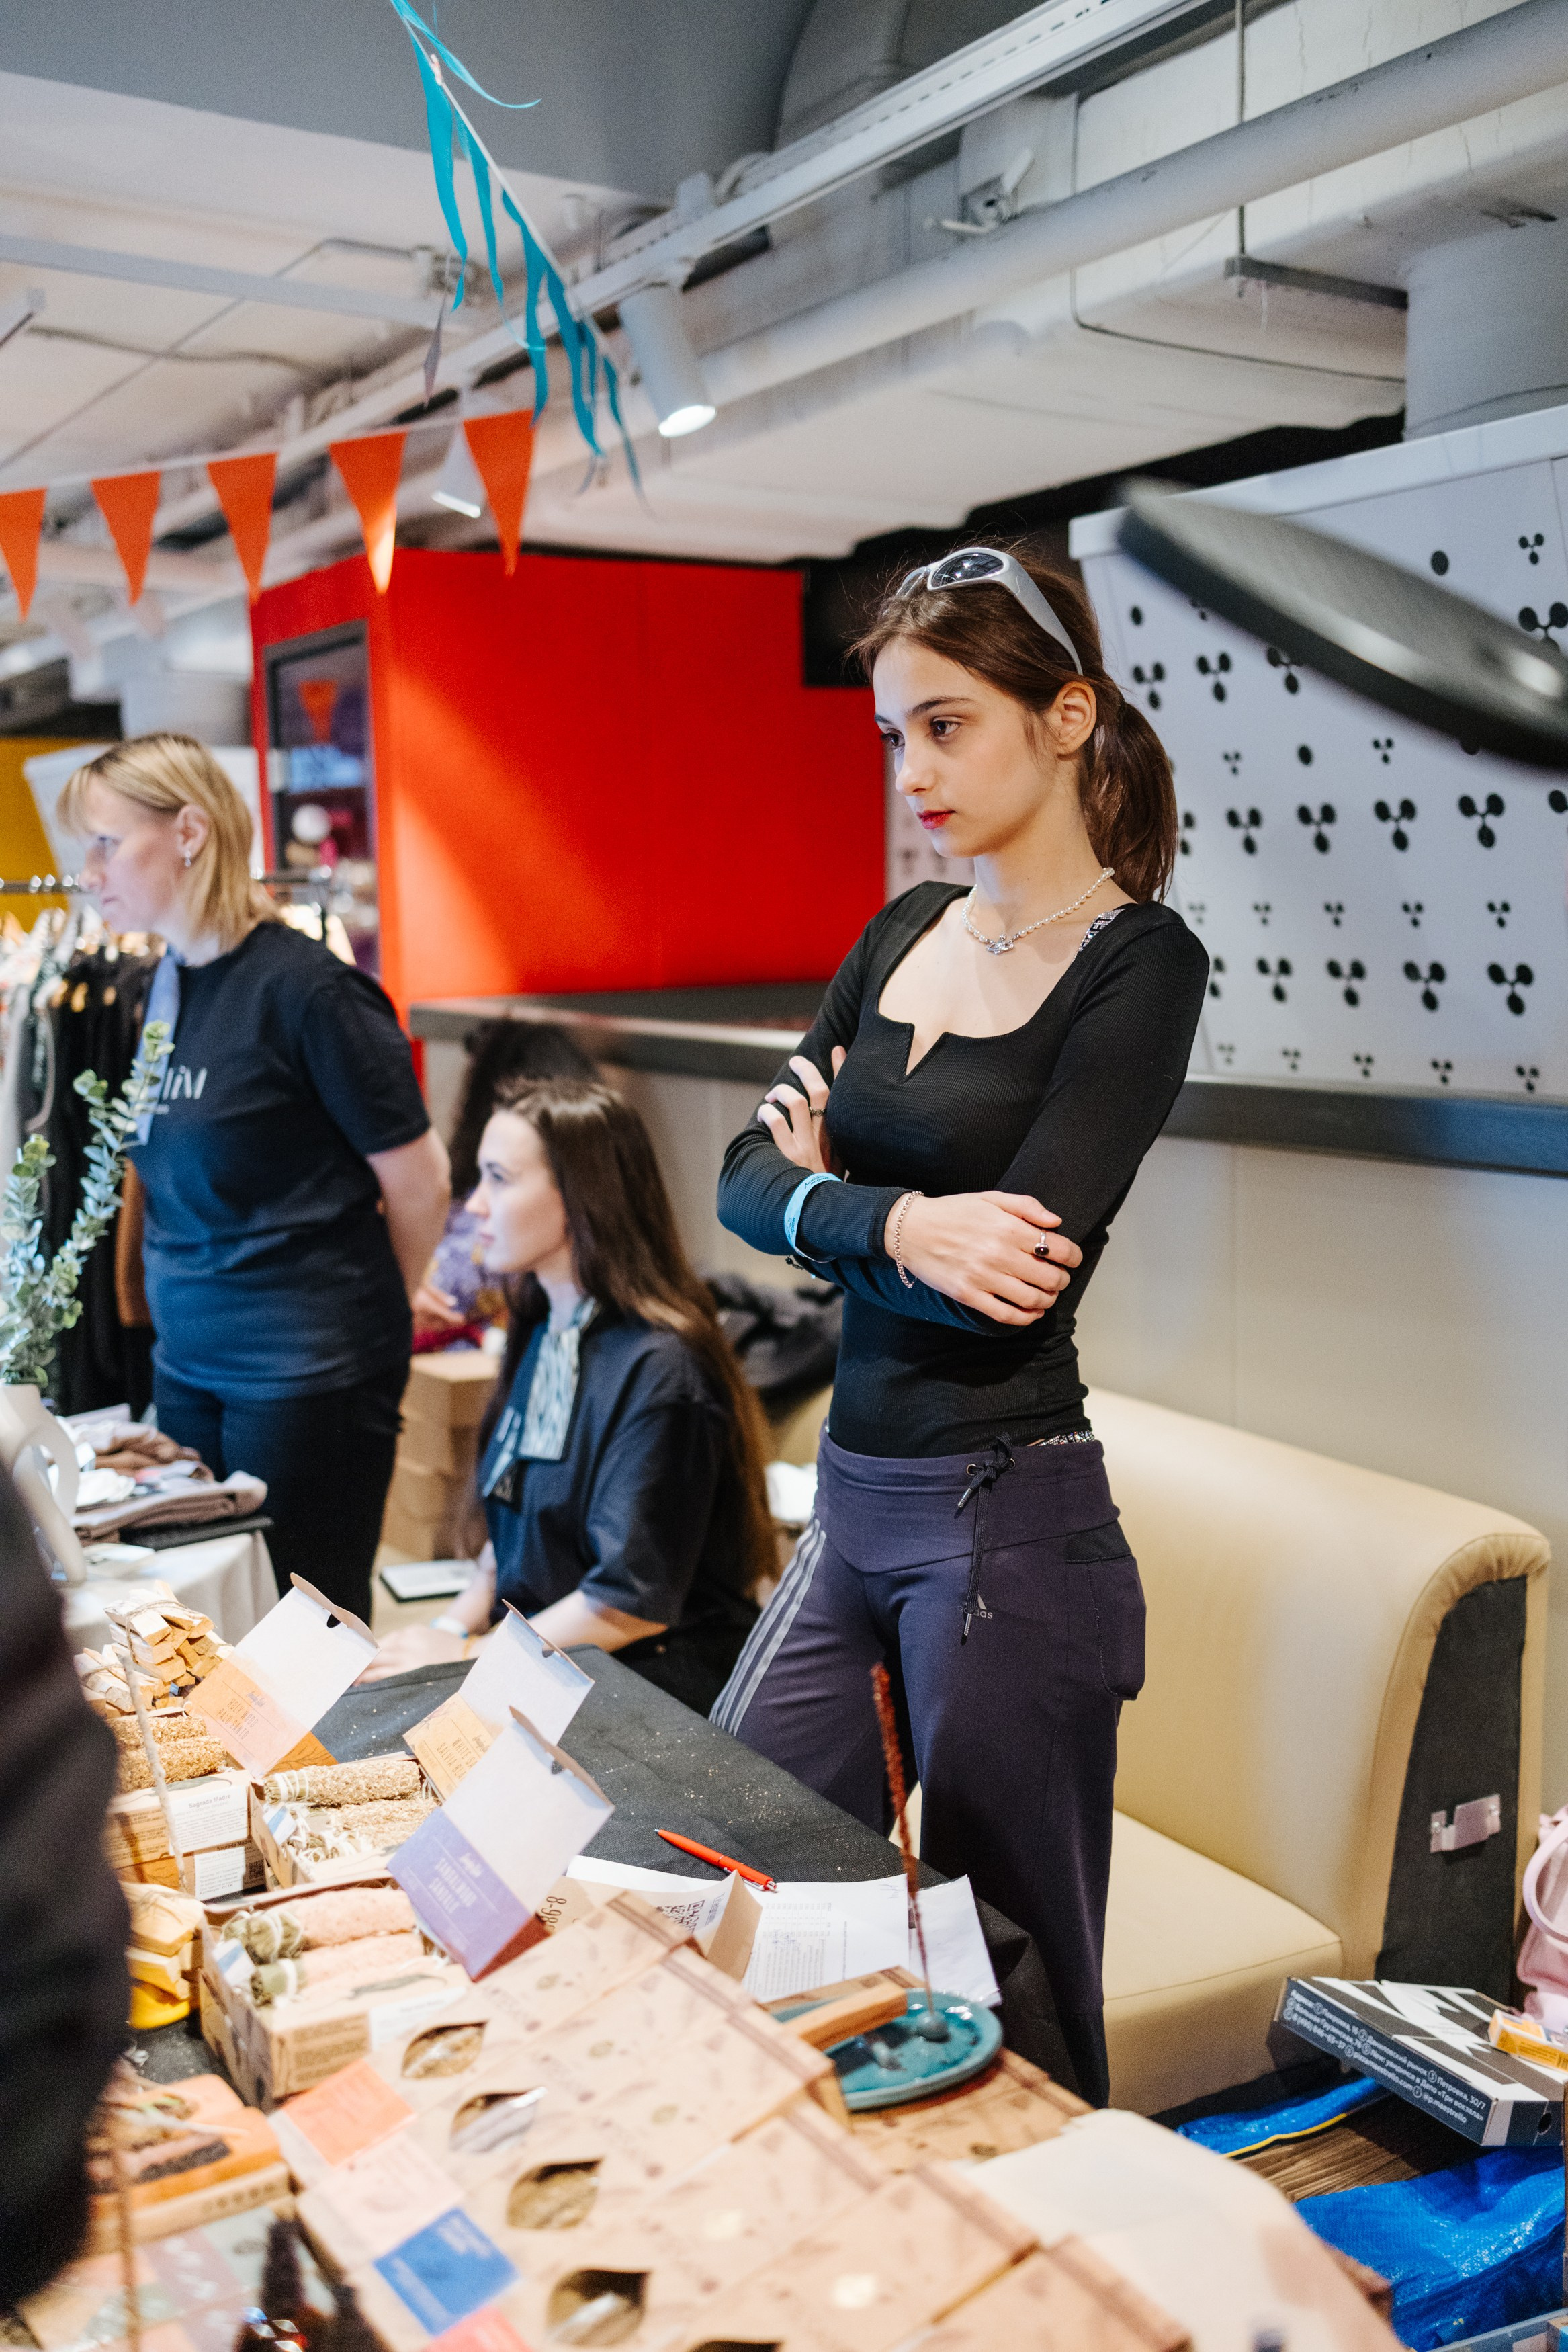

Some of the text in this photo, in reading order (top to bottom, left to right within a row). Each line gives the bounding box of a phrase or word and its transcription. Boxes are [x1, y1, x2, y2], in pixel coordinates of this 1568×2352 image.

[957, 1605, 993, 1619] adas
[216, 1708, 249, 1740] PALO SANTO
[227, 1698, 244, 1714] HOLY
[241, 1710, 259, 1728] WOOD
[437, 1742, 468, 1782] SALVIA BLA
[451, 1737, 478, 1769] WHITE SA
[189, 1799, 212, 1808] Sagrada
[1436, 2076, 1470, 2101] Петровка,
